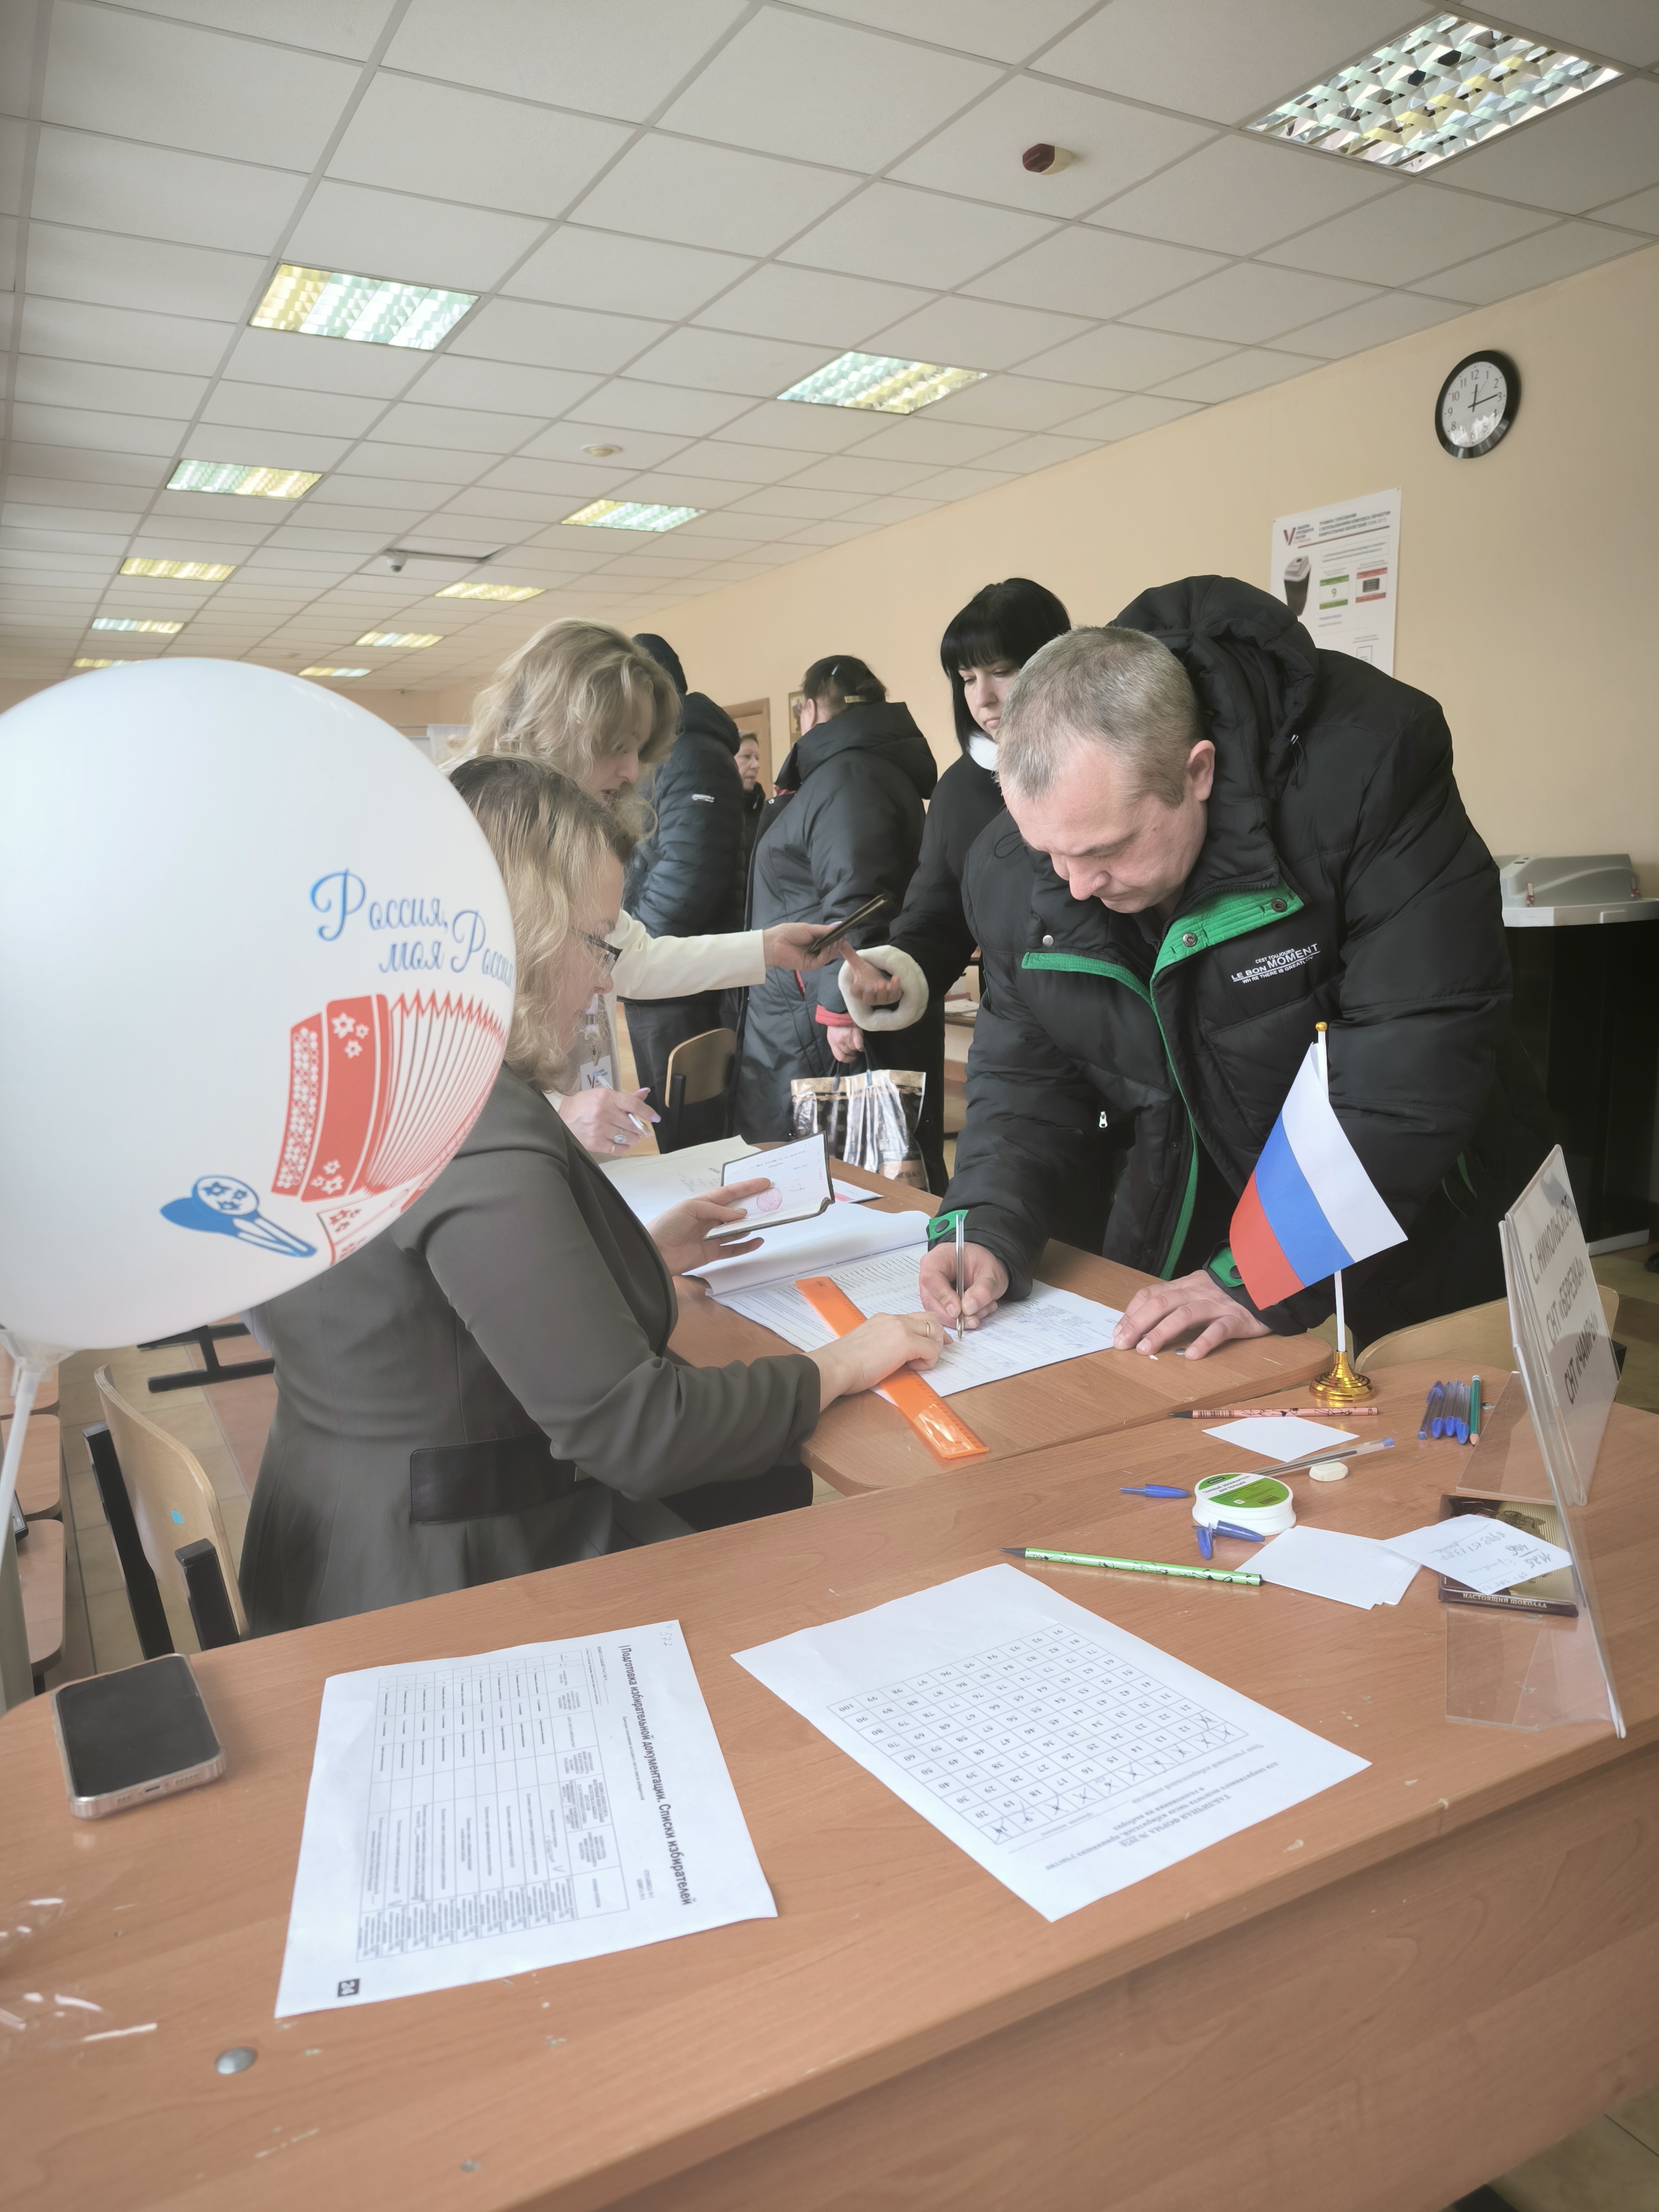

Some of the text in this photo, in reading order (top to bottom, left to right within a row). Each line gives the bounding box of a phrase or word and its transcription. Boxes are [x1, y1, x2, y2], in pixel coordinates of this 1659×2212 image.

[1471, 369, 1479, 380] 12
[1460, 377, 1467, 388] 11
[1493, 378, 1499, 389] 2
[1452, 391, 1460, 402] 10
[1497, 392, 1502, 402] 3
[1447, 407, 1453, 417] 9
[1451, 421, 1456, 431] 8
[1470, 430, 1476, 440] 6
[309, 867, 449, 942] Россия,
[379, 940, 446, 974] моя
[1268, 948, 1295, 961] TOUJOURS
[1231, 943, 1318, 981] LE BON MOMENT
[1259, 970, 1278, 979] THERE
[1529, 1195, 1575, 1285] С. НИКОЛЬСКОЕ,
[1546, 1256, 1588, 1347] СНТ «БЕРЕЗКА»,
[1564, 1309, 1599, 1405] СНТ «ЧАМРЫ»
[1462, 1593, 1547, 1609] НАСТОЯЩИЙ ШОКОЛАД
[621, 1648, 637, 1685] Подготовка
[838, 1703, 854, 1712] 100
[630, 1686, 654, 1740] избирательной
[1115, 1710, 1128, 1718] 33
[1067, 1730, 1080, 1738] 35
[1086, 1743, 1099, 1751] 25
[1018, 1750, 1030, 1759] 37
[1061, 1752, 1075, 1761] 26
[1106, 1756, 1119, 1764] 15
[641, 1742, 666, 1803] документации.
[1037, 1764, 1049, 1772] 27
[1081, 1766, 1094, 1775] 16
[1009, 1775, 1023, 1783] 28
[1056, 1778, 1068, 1786] 17
[984, 1785, 996, 1793] 29
[1029, 1789, 1042, 1797] 18
[956, 1796, 969, 1804] 30
[1003, 1800, 1015, 1808] 19
[975, 1810, 989, 1819] 20
[659, 1804, 676, 1839] Списки
[1148, 1818, 1181, 1834] ФОРМА
[667, 1840, 696, 1905] избирателей
[340, 1980, 356, 1995] 24
